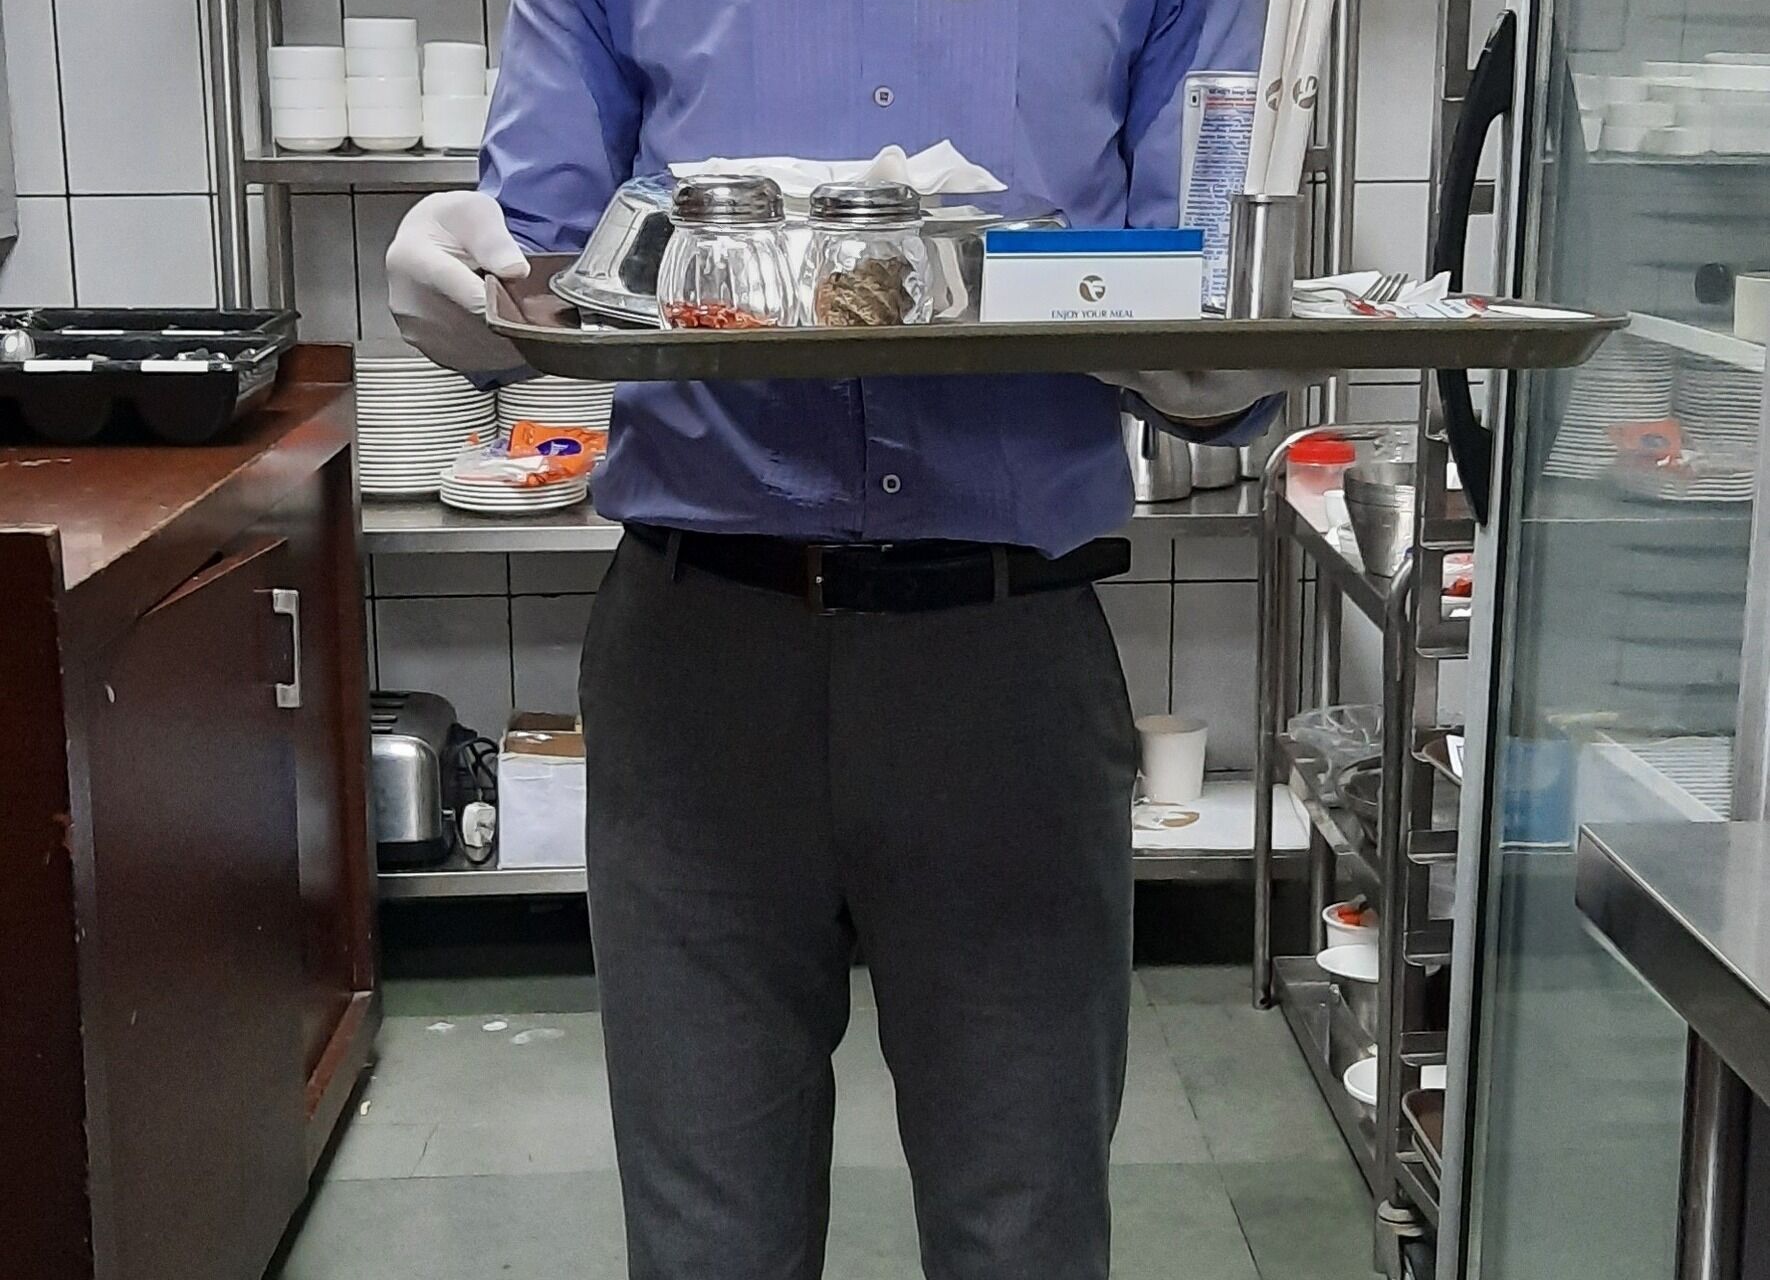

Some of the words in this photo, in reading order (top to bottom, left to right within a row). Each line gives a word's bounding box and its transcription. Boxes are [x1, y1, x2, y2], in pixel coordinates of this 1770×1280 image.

[1051, 310, 1079, 320] ENJOY
[1082, 310, 1107, 318] YOUR
[1110, 310, 1134, 318] MEAL
